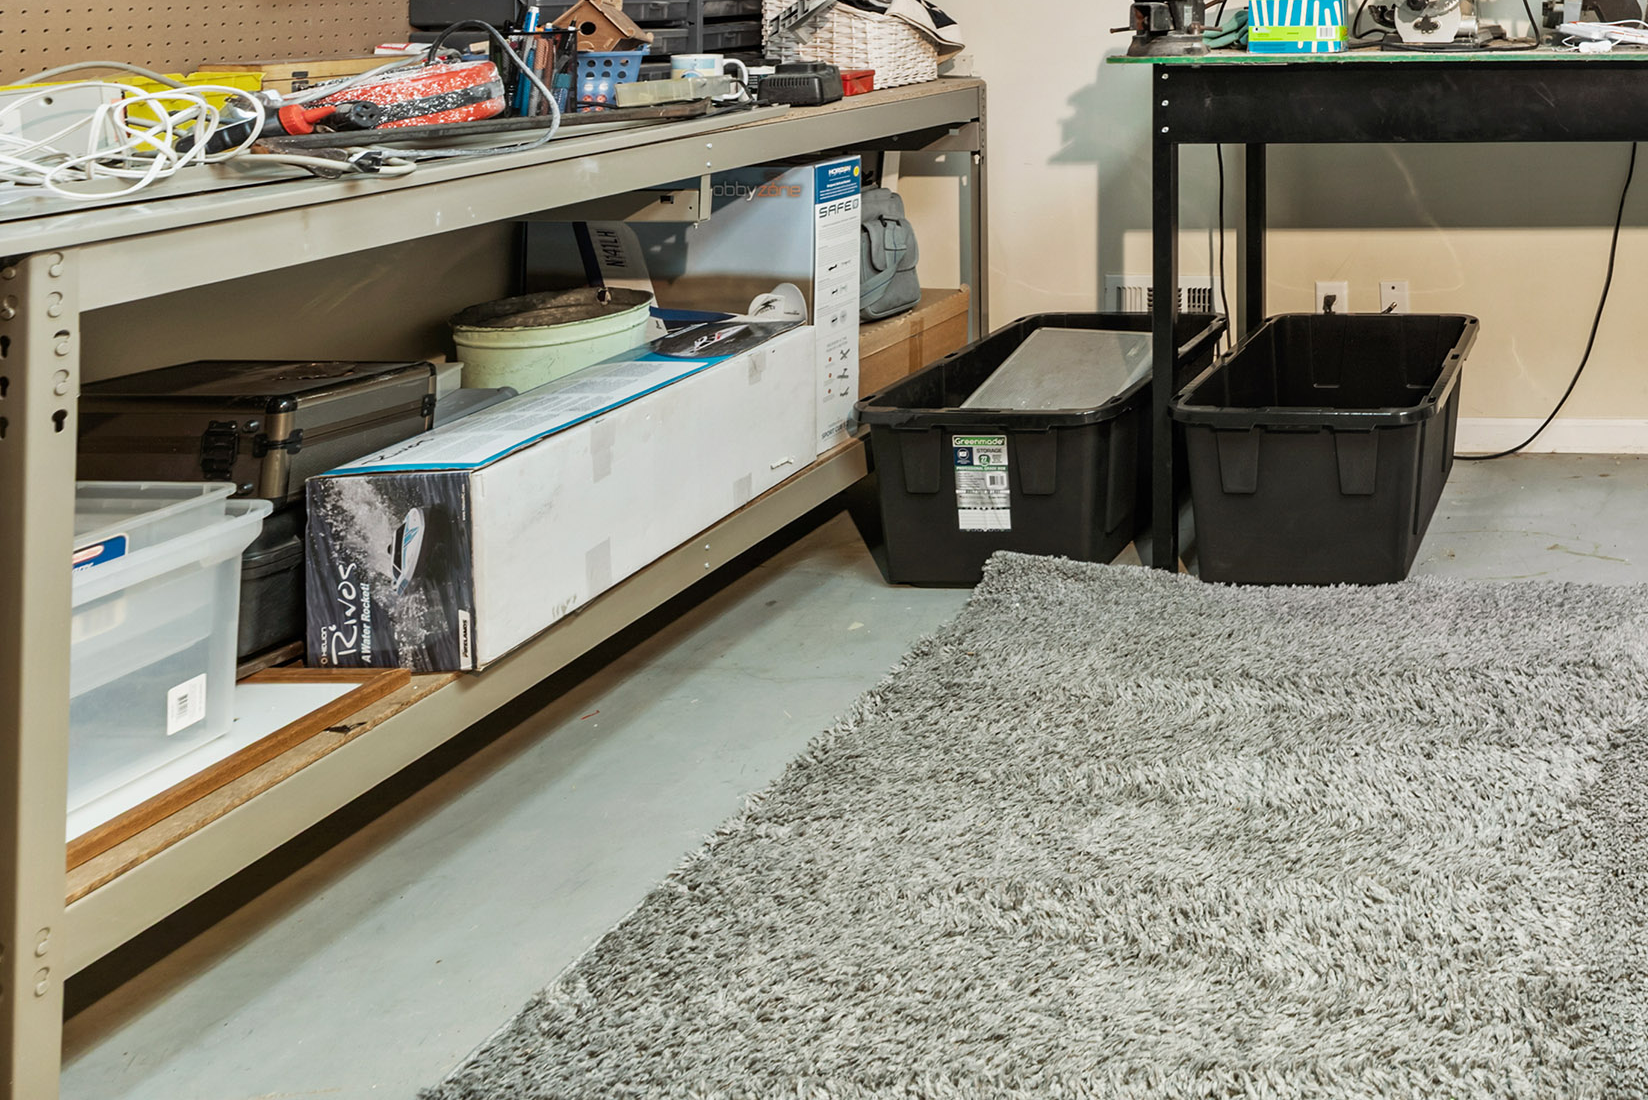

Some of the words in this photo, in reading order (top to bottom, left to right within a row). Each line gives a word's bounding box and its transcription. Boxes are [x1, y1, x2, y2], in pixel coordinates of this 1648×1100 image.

[711, 181, 802, 201] obbyzone
[819, 200, 852, 219] SAFE
[954, 437, 1003, 445] Greenmade
[360, 582, 371, 622] Rocket!
[361, 626, 372, 654] Water
